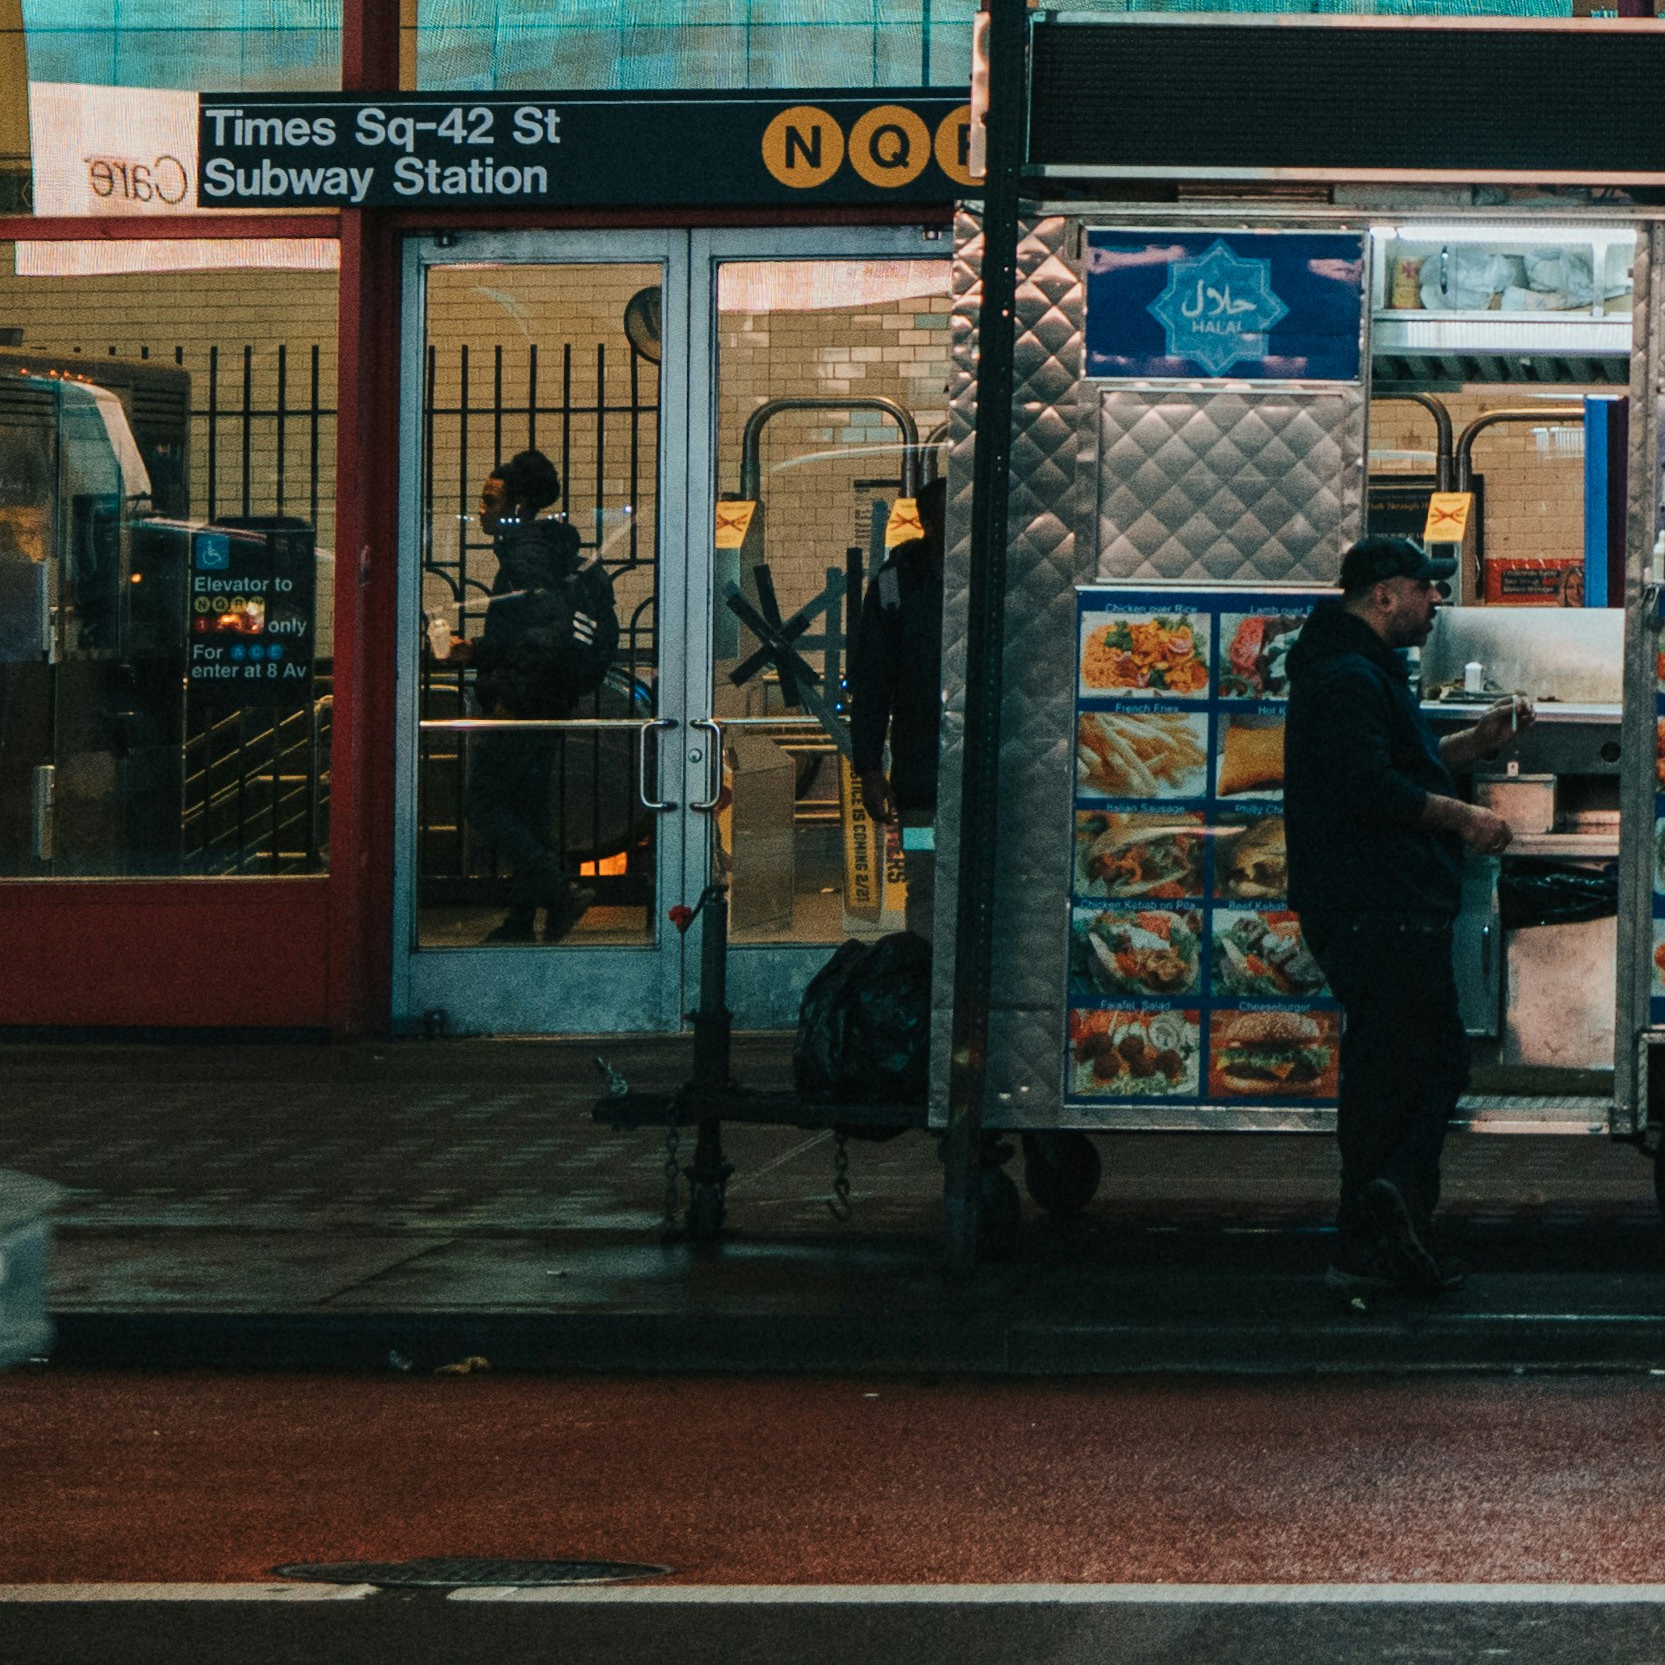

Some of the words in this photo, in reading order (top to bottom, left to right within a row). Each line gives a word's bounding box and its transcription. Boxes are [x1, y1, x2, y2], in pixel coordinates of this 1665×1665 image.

[205, 108, 336, 148] Times
[355, 107, 496, 155] Sq-42
[512, 106, 561, 145] St
[784, 128, 823, 167] N
[869, 126, 909, 171] Q
[205, 160, 373, 202] Subway
[394, 159, 548, 196] Station
[1181, 279, 1257, 318] حلال
[1192, 320, 1242, 335] HALAL
[194, 576, 271, 592] Elevator
[274, 577, 293, 592] to
[1105, 603, 1149, 614] Chicken
[1150, 606, 1172, 614] over
[1174, 604, 1198, 614] Rice
[1250, 605, 1279, 615] Lamb
[268, 618, 307, 637] only
[193, 644, 224, 659] For
[191, 664, 239, 678] enter
[244, 664, 262, 678] at
[267, 663, 278, 678] 8
[283, 663, 307, 678] Av
[1115, 703, 1150, 713] French
[1154, 703, 1180, 713] Fries
[1107, 803, 1138, 813] Italian
[1141, 803, 1186, 815] Sausage
[854, 824, 869, 871] COMING
[1080, 900, 1121, 910] Chicken
[1124, 900, 1159, 910] Kebab
[1160, 902, 1173, 910] on
[1100, 1000, 1136, 1010] Falafel
[1141, 1000, 1171, 1010] Salad
[1238, 1000, 1311, 1012] Cheeseburger
